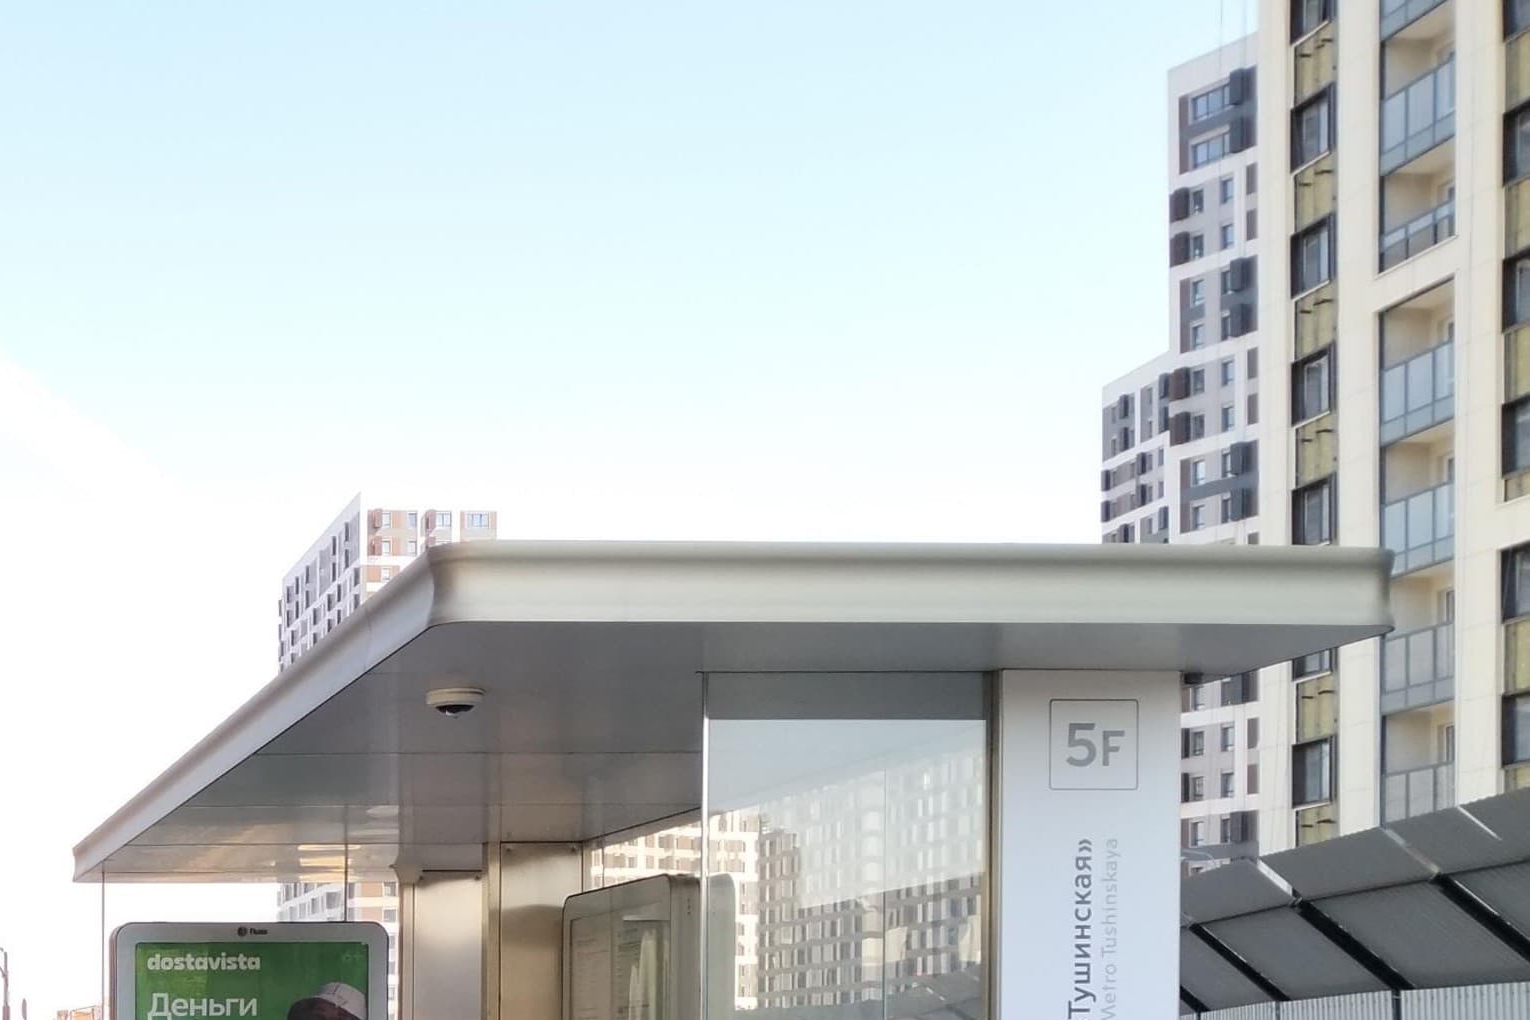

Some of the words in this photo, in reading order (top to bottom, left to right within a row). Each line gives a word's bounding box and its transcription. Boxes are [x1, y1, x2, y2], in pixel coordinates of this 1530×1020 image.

[1065, 722, 1126, 767] 5F
[1101, 838, 1121, 958] Tushinskaya
[147, 952, 261, 971] dostavista
